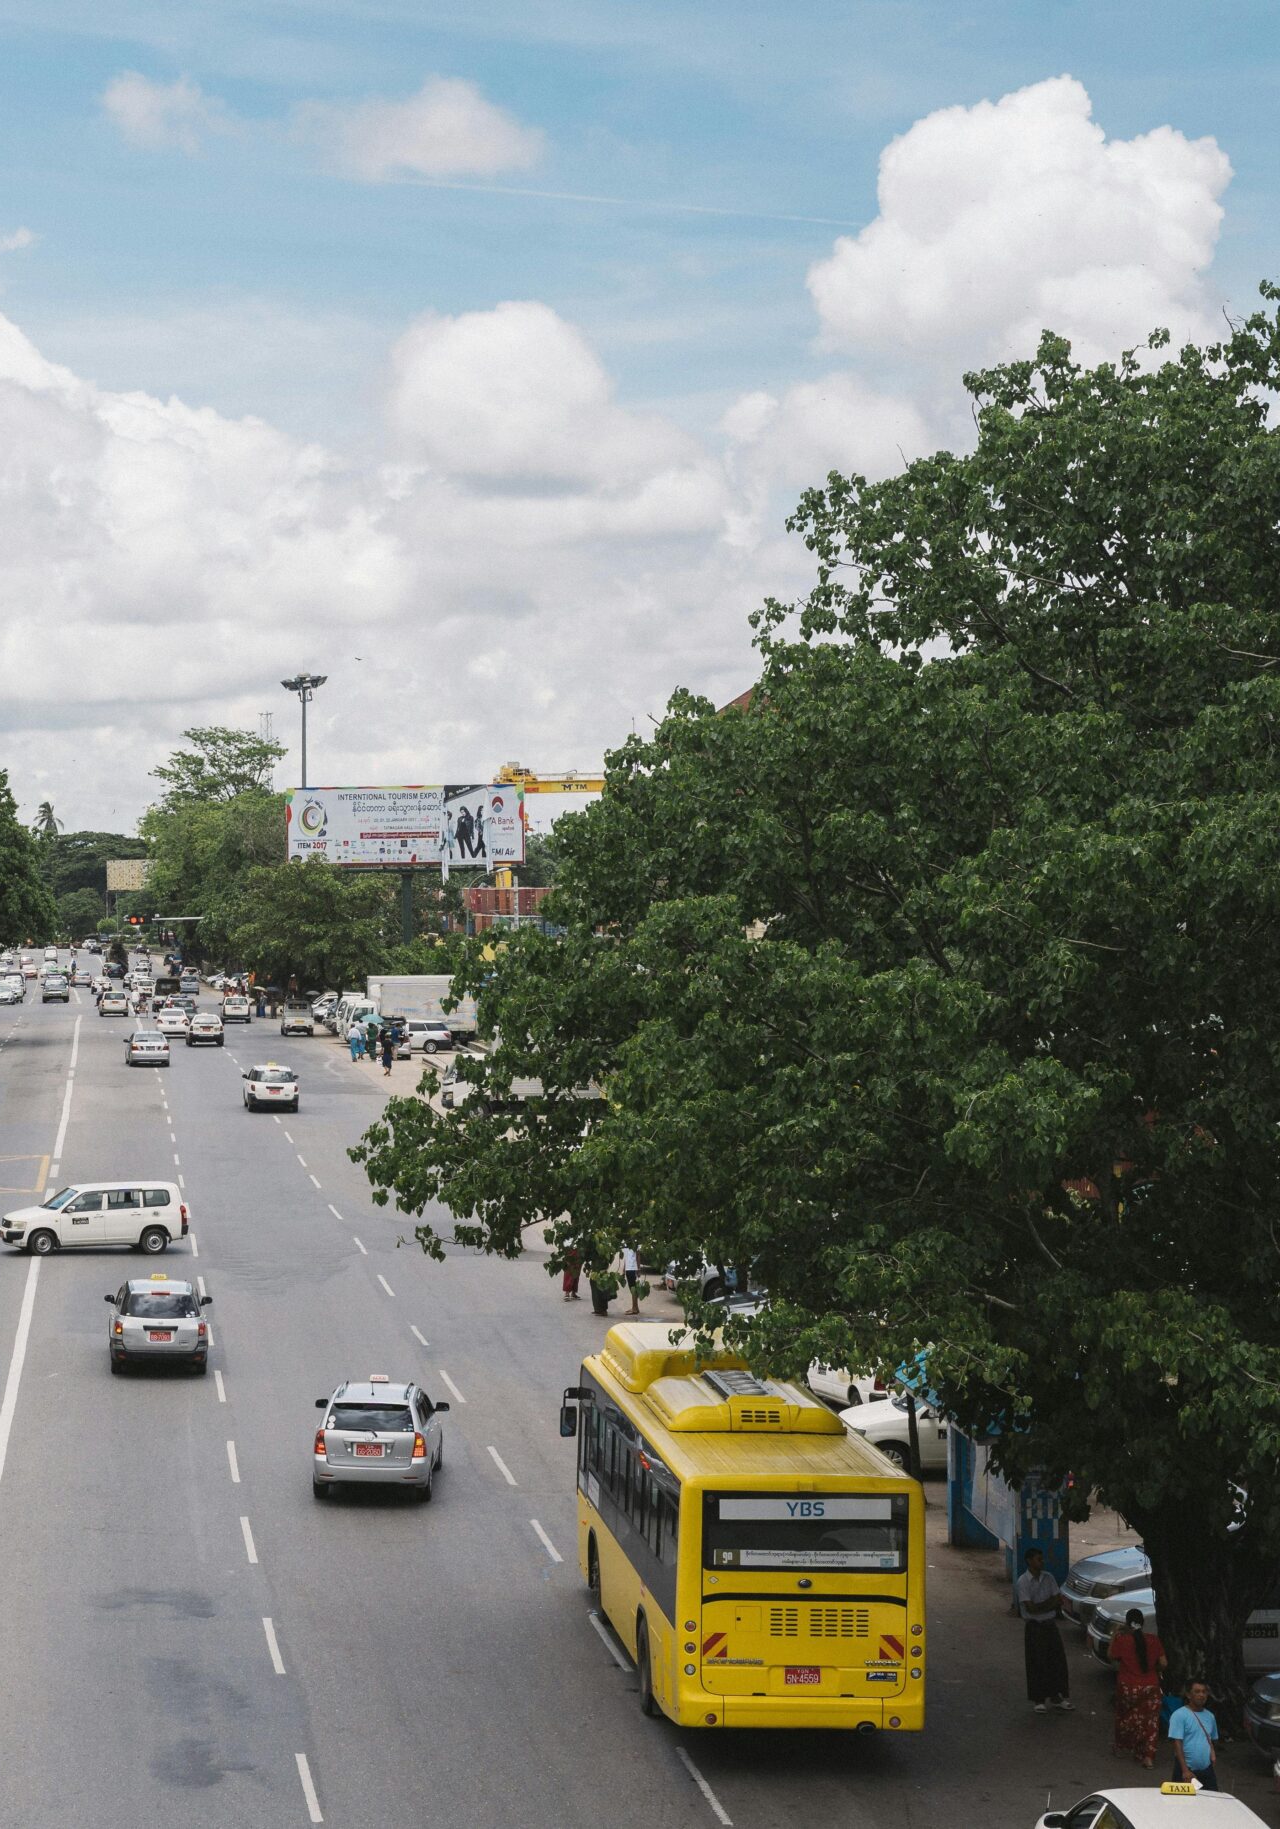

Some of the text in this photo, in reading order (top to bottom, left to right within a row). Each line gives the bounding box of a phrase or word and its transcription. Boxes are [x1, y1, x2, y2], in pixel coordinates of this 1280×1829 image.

[388, 792, 418, 800] TOURISM
[497, 817, 515, 825] Bank
[312, 841, 328, 851] 2017
[504, 848, 515, 856] Air
[786, 1501, 825, 1517] YBS
[786, 1673, 819, 1684] 5N-4559
[1170, 1785, 1190, 1793] TAXI
